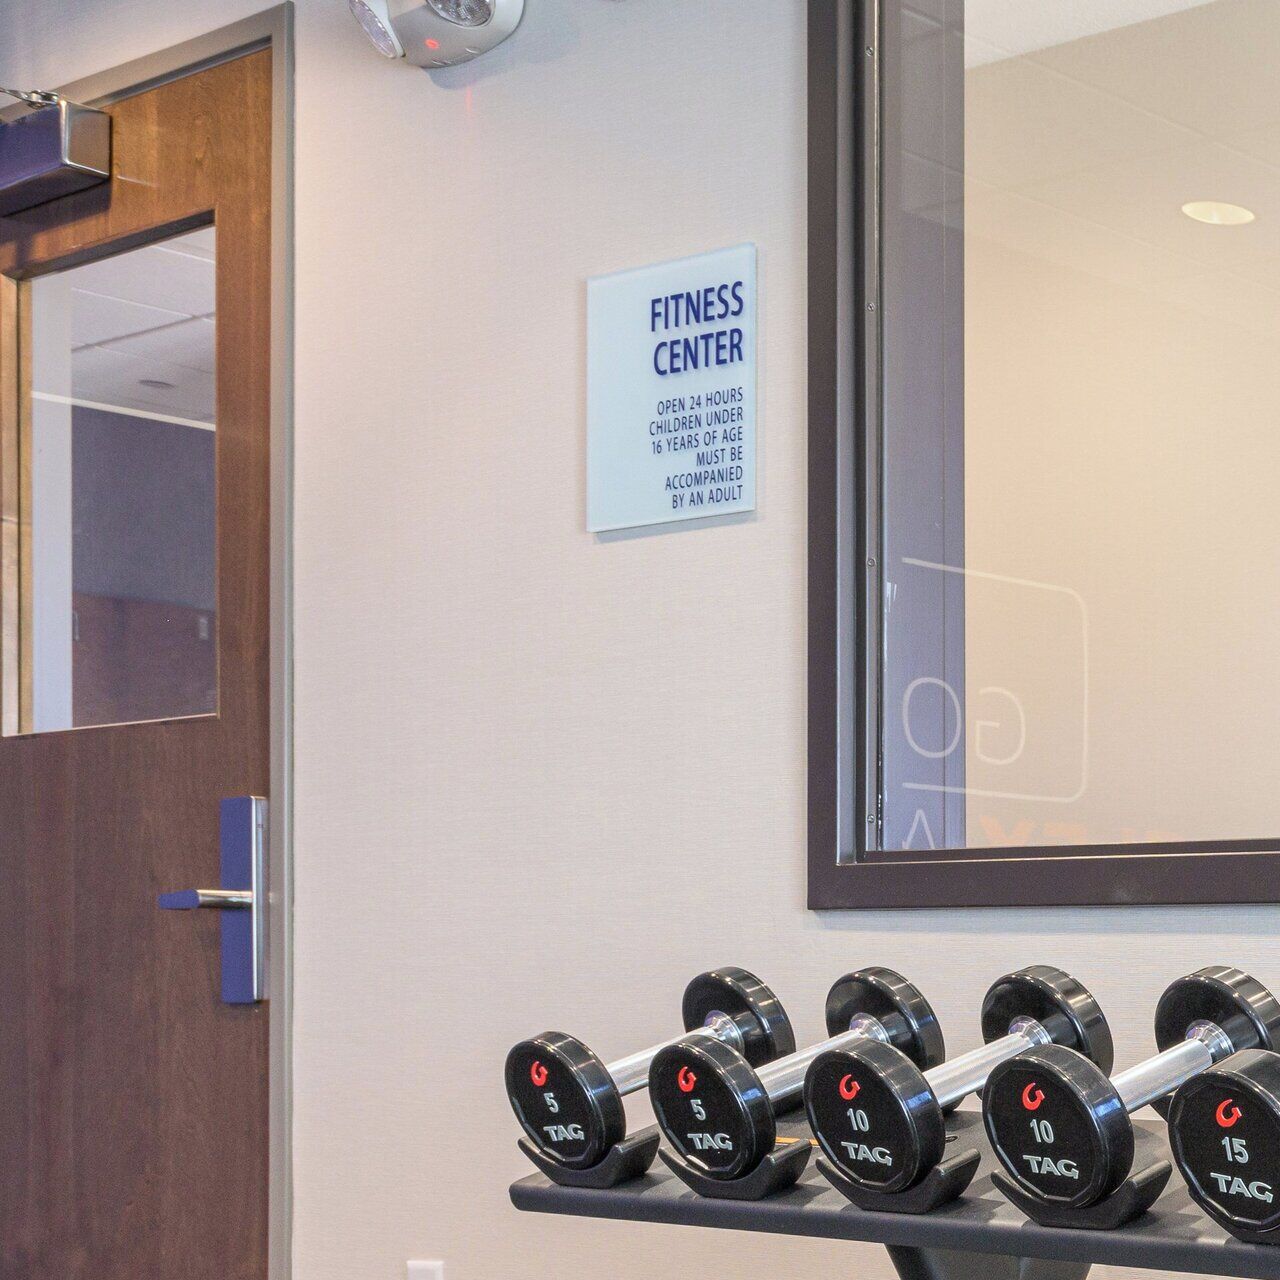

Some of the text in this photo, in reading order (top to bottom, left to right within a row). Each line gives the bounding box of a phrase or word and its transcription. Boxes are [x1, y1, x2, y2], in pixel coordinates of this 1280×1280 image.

[651, 281, 743, 332] FITNESS
[654, 328, 743, 375] CENTER
[657, 387, 743, 415] OPEN 24 HOURS
[649, 407, 743, 435] CHILDREN UNDER
[652, 426, 743, 454] 16 YEARS OF AGE
[696, 446, 743, 466] MUST BE
[665, 466, 743, 491] ACCOMPANIED
[672, 485, 743, 509] BY AN ADULT
[543, 1092, 560, 1114] 5
[689, 1098, 707, 1121] 5
[846, 1107, 870, 1132] 10
[1029, 1118, 1055, 1144] 10
[543, 1123, 585, 1142] TAG
[687, 1132, 733, 1151] TAG
[841, 1141, 893, 1166] TAG
[1221, 1136, 1250, 1164] 15
[1022, 1154, 1080, 1180] TAG
[1210, 1173, 1274, 1203] TAG
